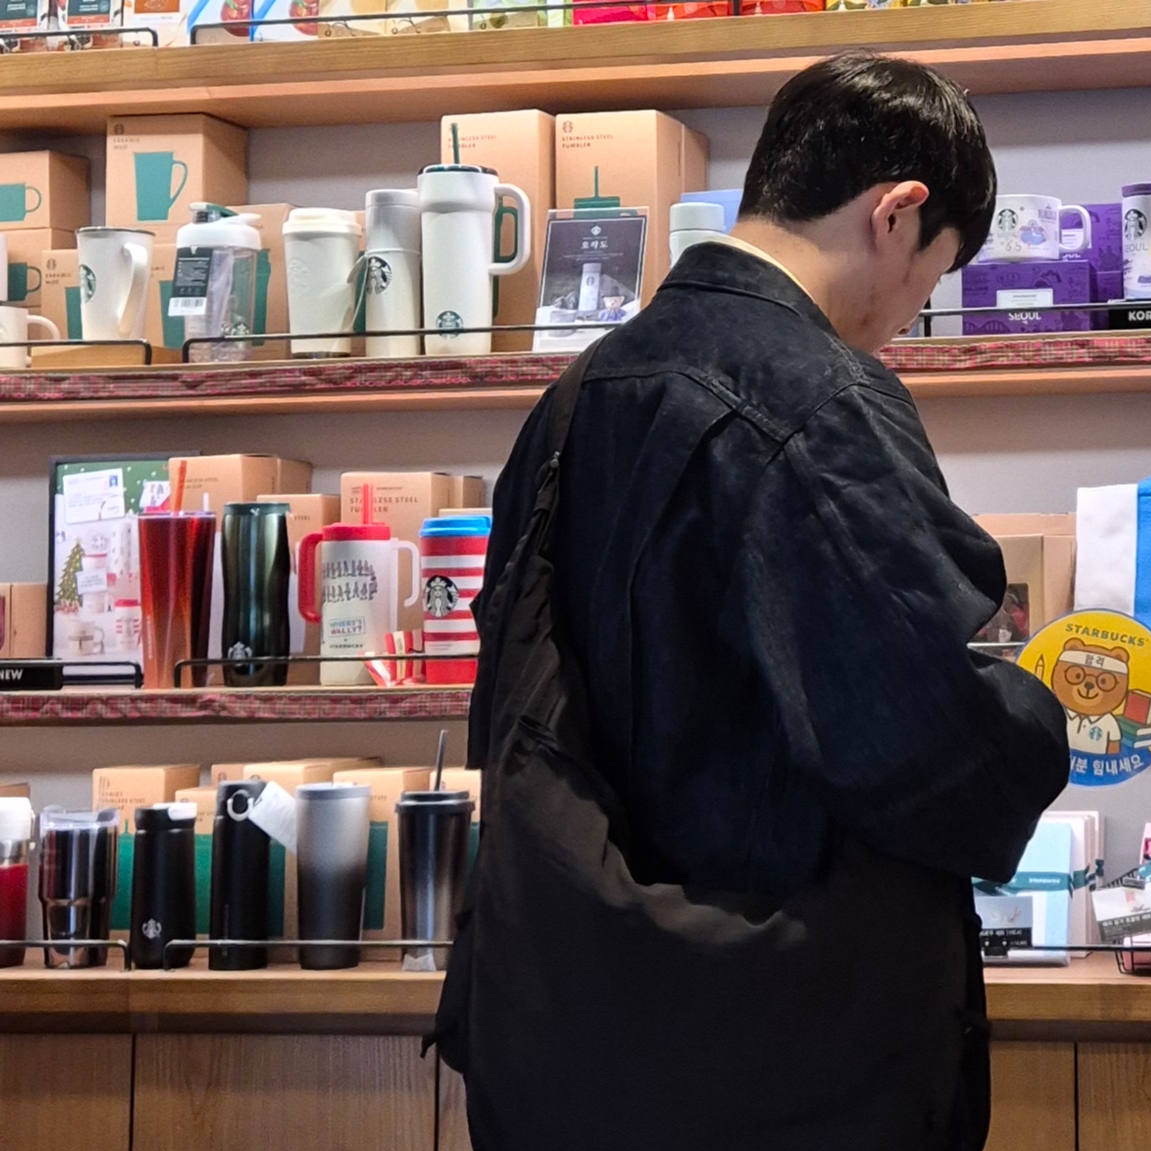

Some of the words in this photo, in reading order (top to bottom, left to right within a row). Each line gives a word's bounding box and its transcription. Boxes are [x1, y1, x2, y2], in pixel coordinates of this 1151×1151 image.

[350, 496, 393, 504] STLESS
[1065, 623, 1145, 647] STARBUCKS
[1093, 754, 1144, 776] 힘내세요
